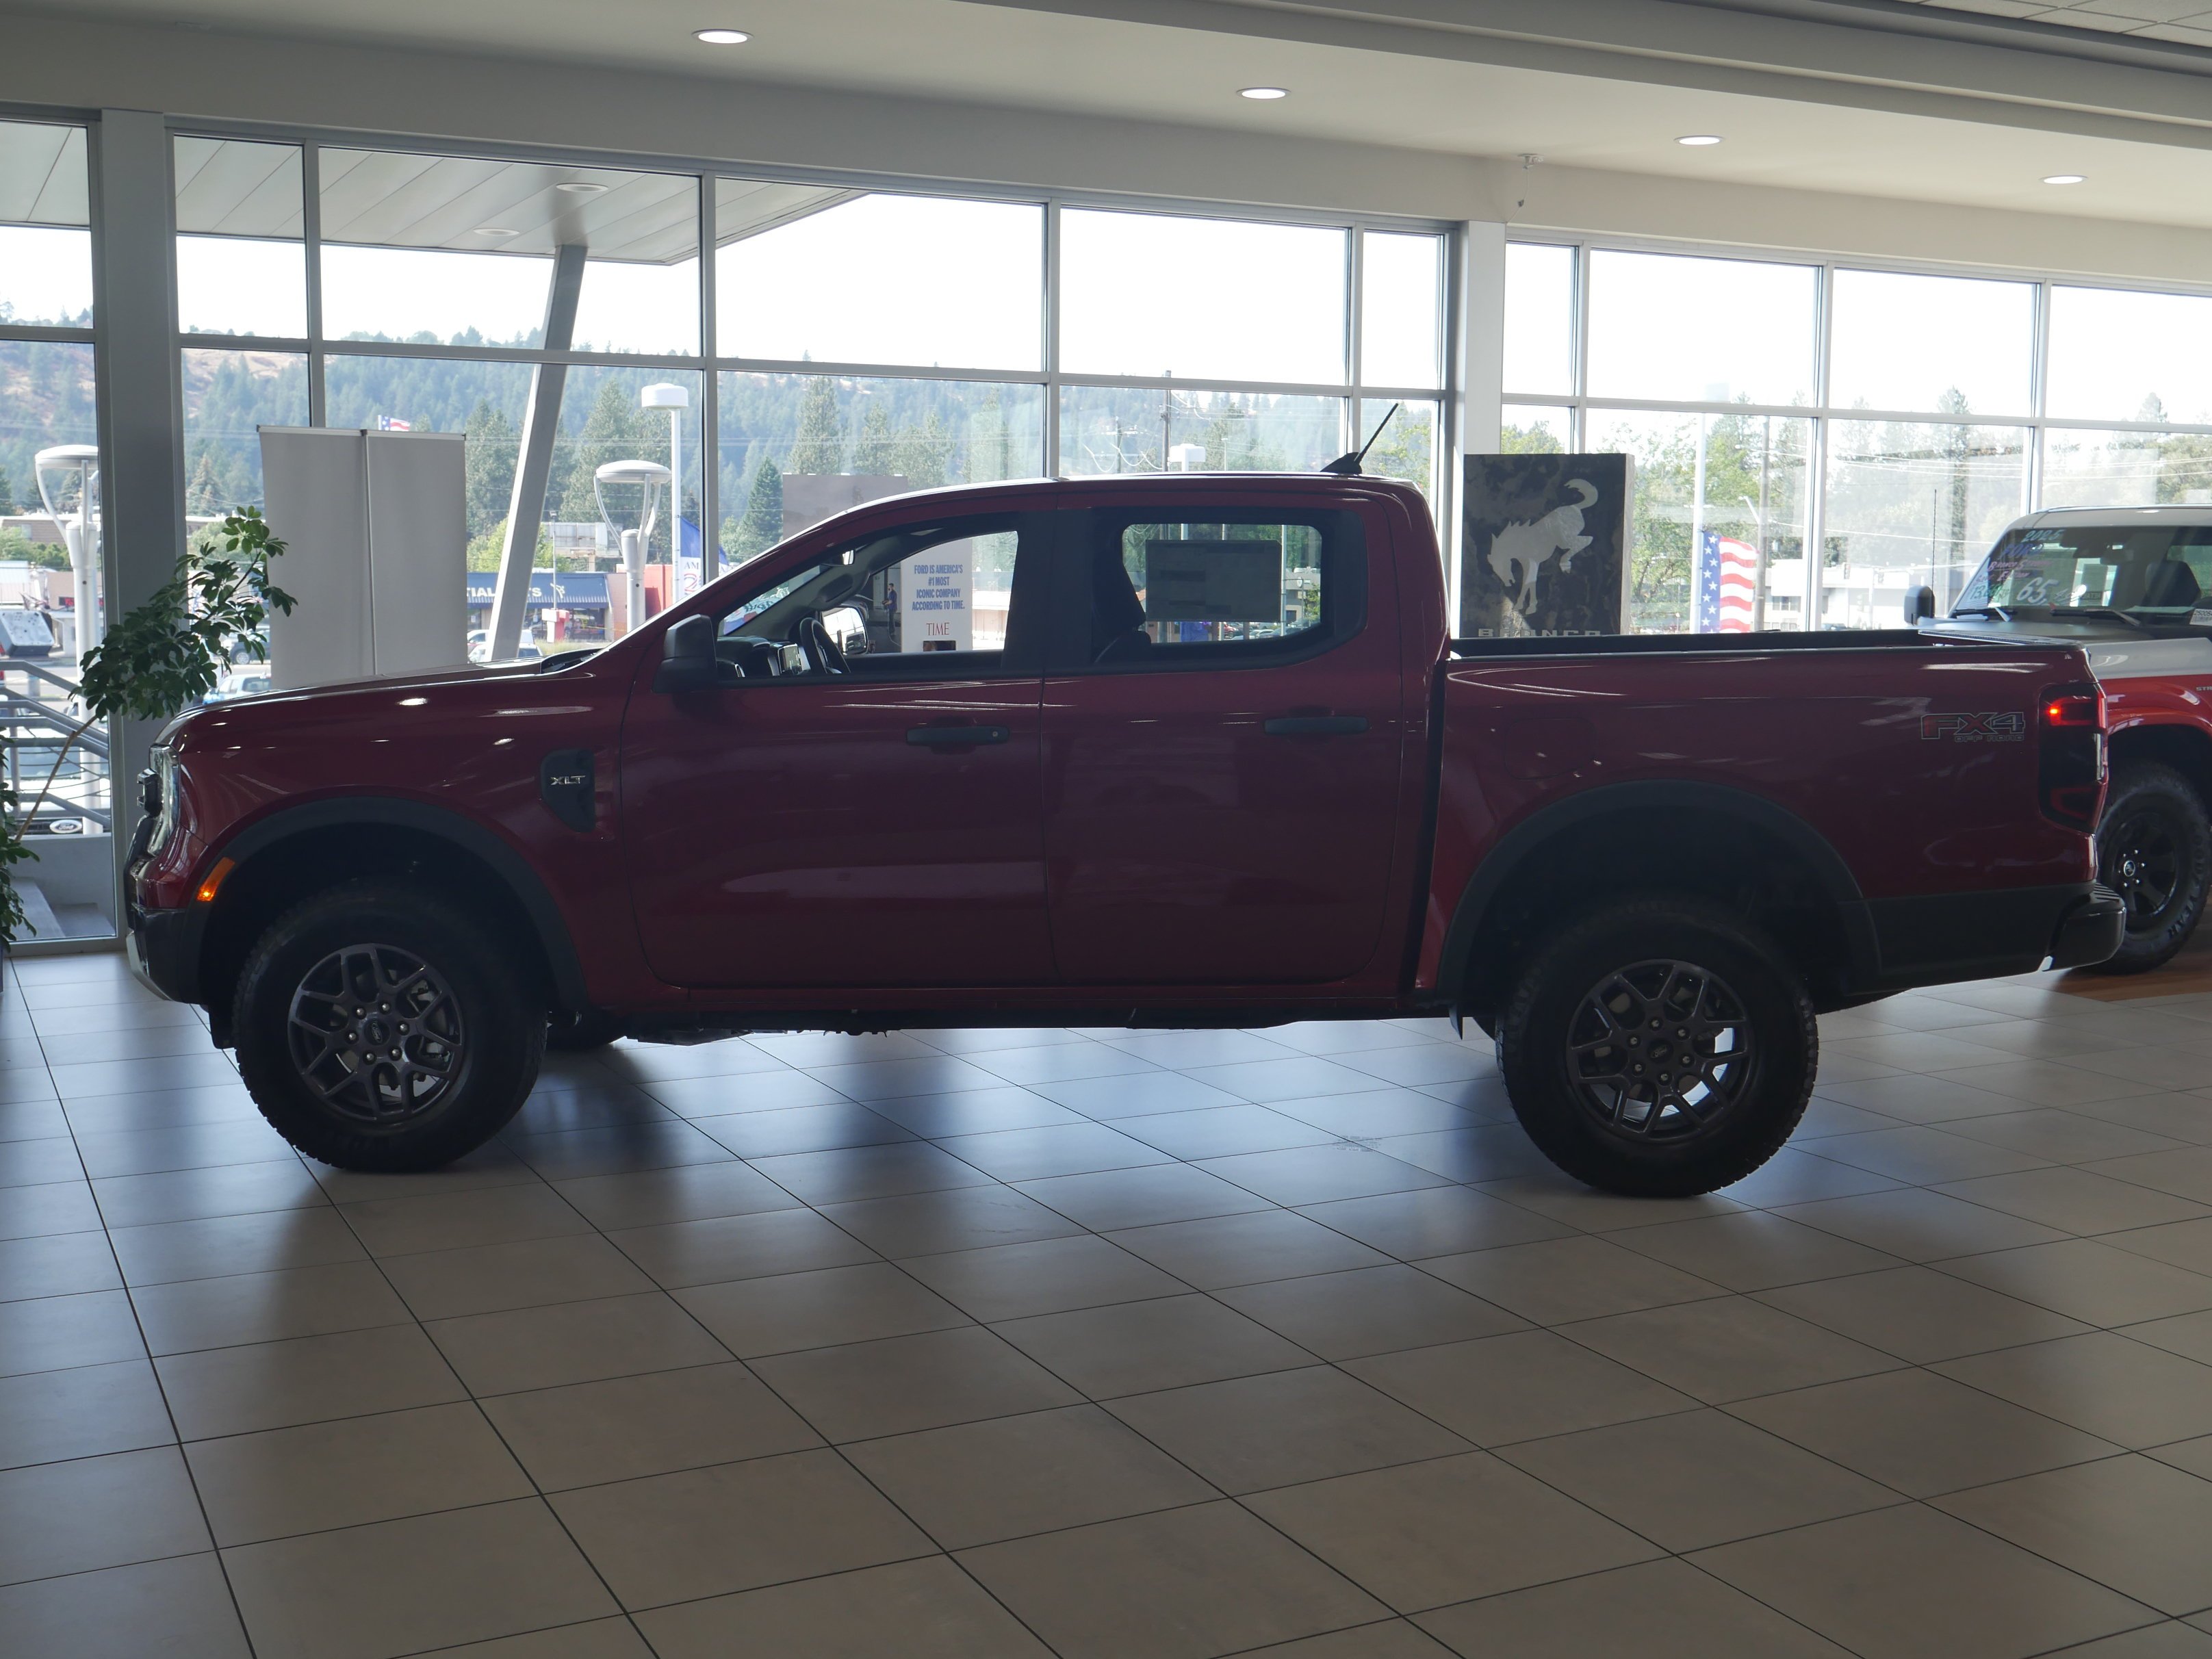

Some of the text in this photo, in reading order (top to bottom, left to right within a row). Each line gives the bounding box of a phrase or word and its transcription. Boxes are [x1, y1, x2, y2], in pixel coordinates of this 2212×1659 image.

[914, 564, 963, 574] FORD IS AMERICA'S
[928, 576, 949, 586] #1 MOST
[916, 588, 961, 598] ICONIC COMPANY
[912, 600, 965, 611] ACCORDING TO TIME.
[926, 622, 950, 636] TIME
[1920, 712, 2026, 740] FX4
[550, 775, 587, 785] XLT
